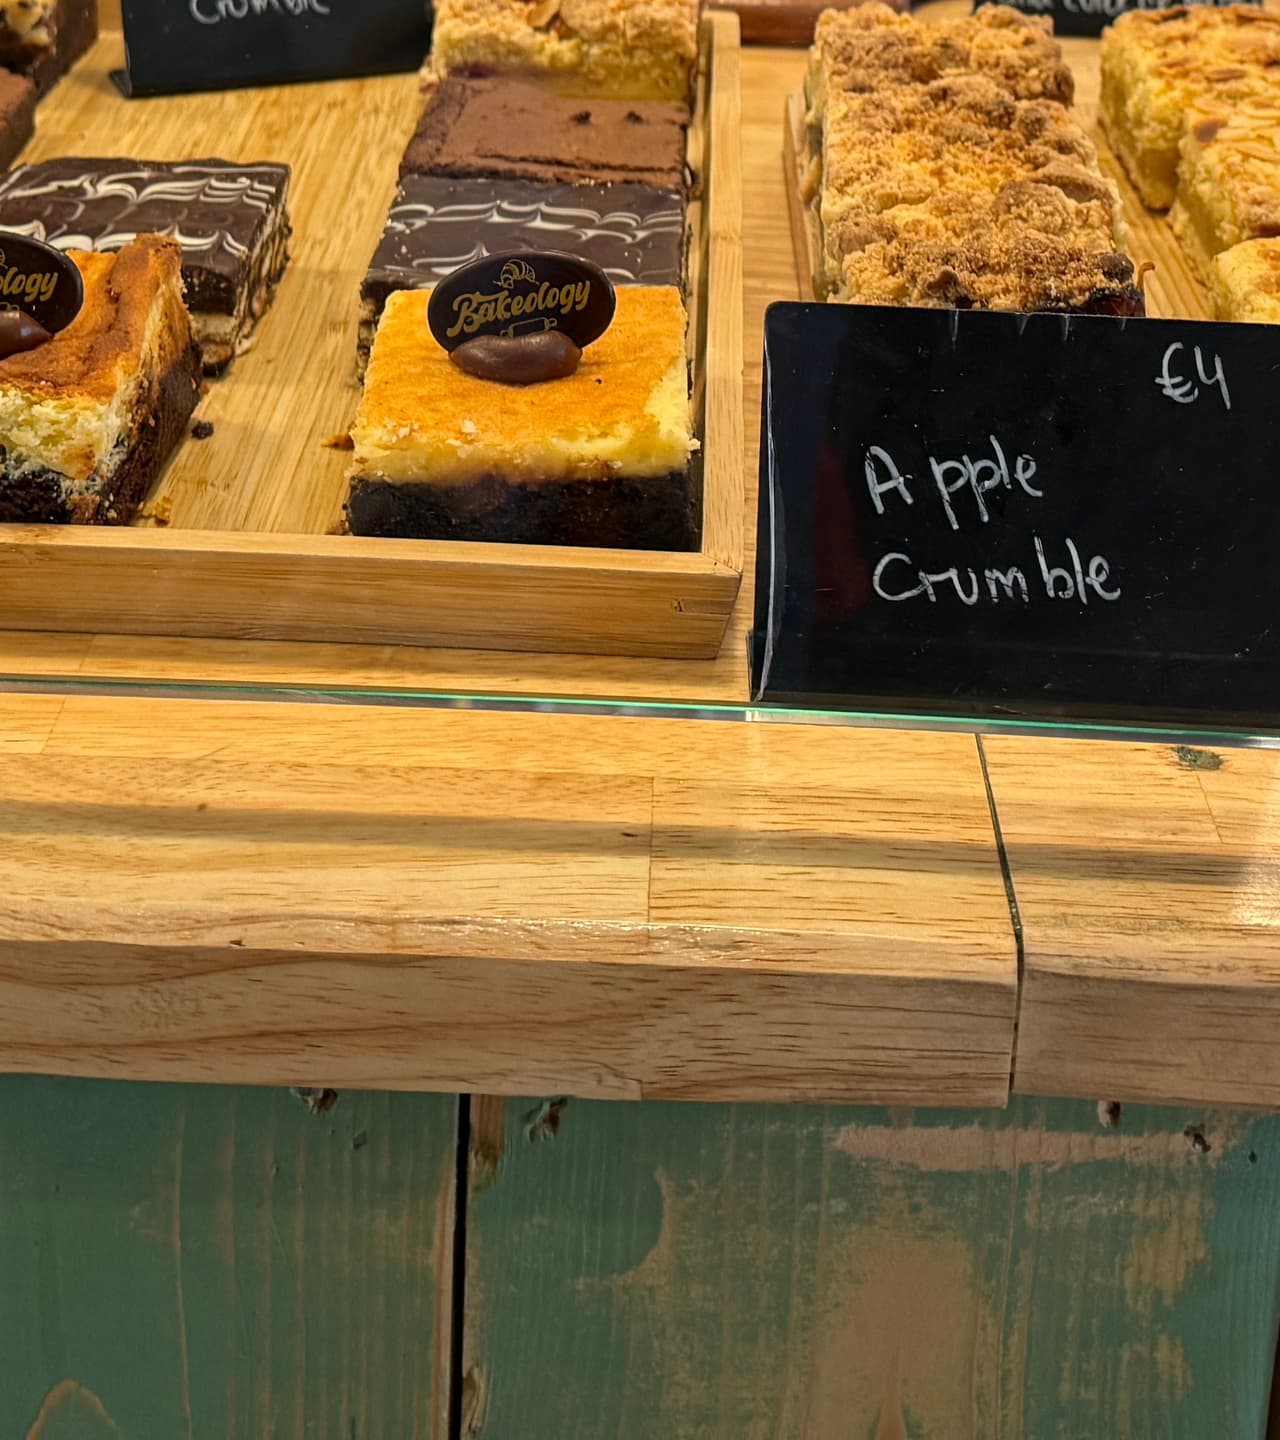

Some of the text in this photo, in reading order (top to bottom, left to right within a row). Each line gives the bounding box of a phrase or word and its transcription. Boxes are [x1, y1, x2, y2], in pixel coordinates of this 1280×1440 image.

[446, 280, 590, 337] Bakeology
[1154, 342, 1231, 409] €4
[864, 435, 1043, 530] Apple
[873, 537, 1121, 604] Crumble
